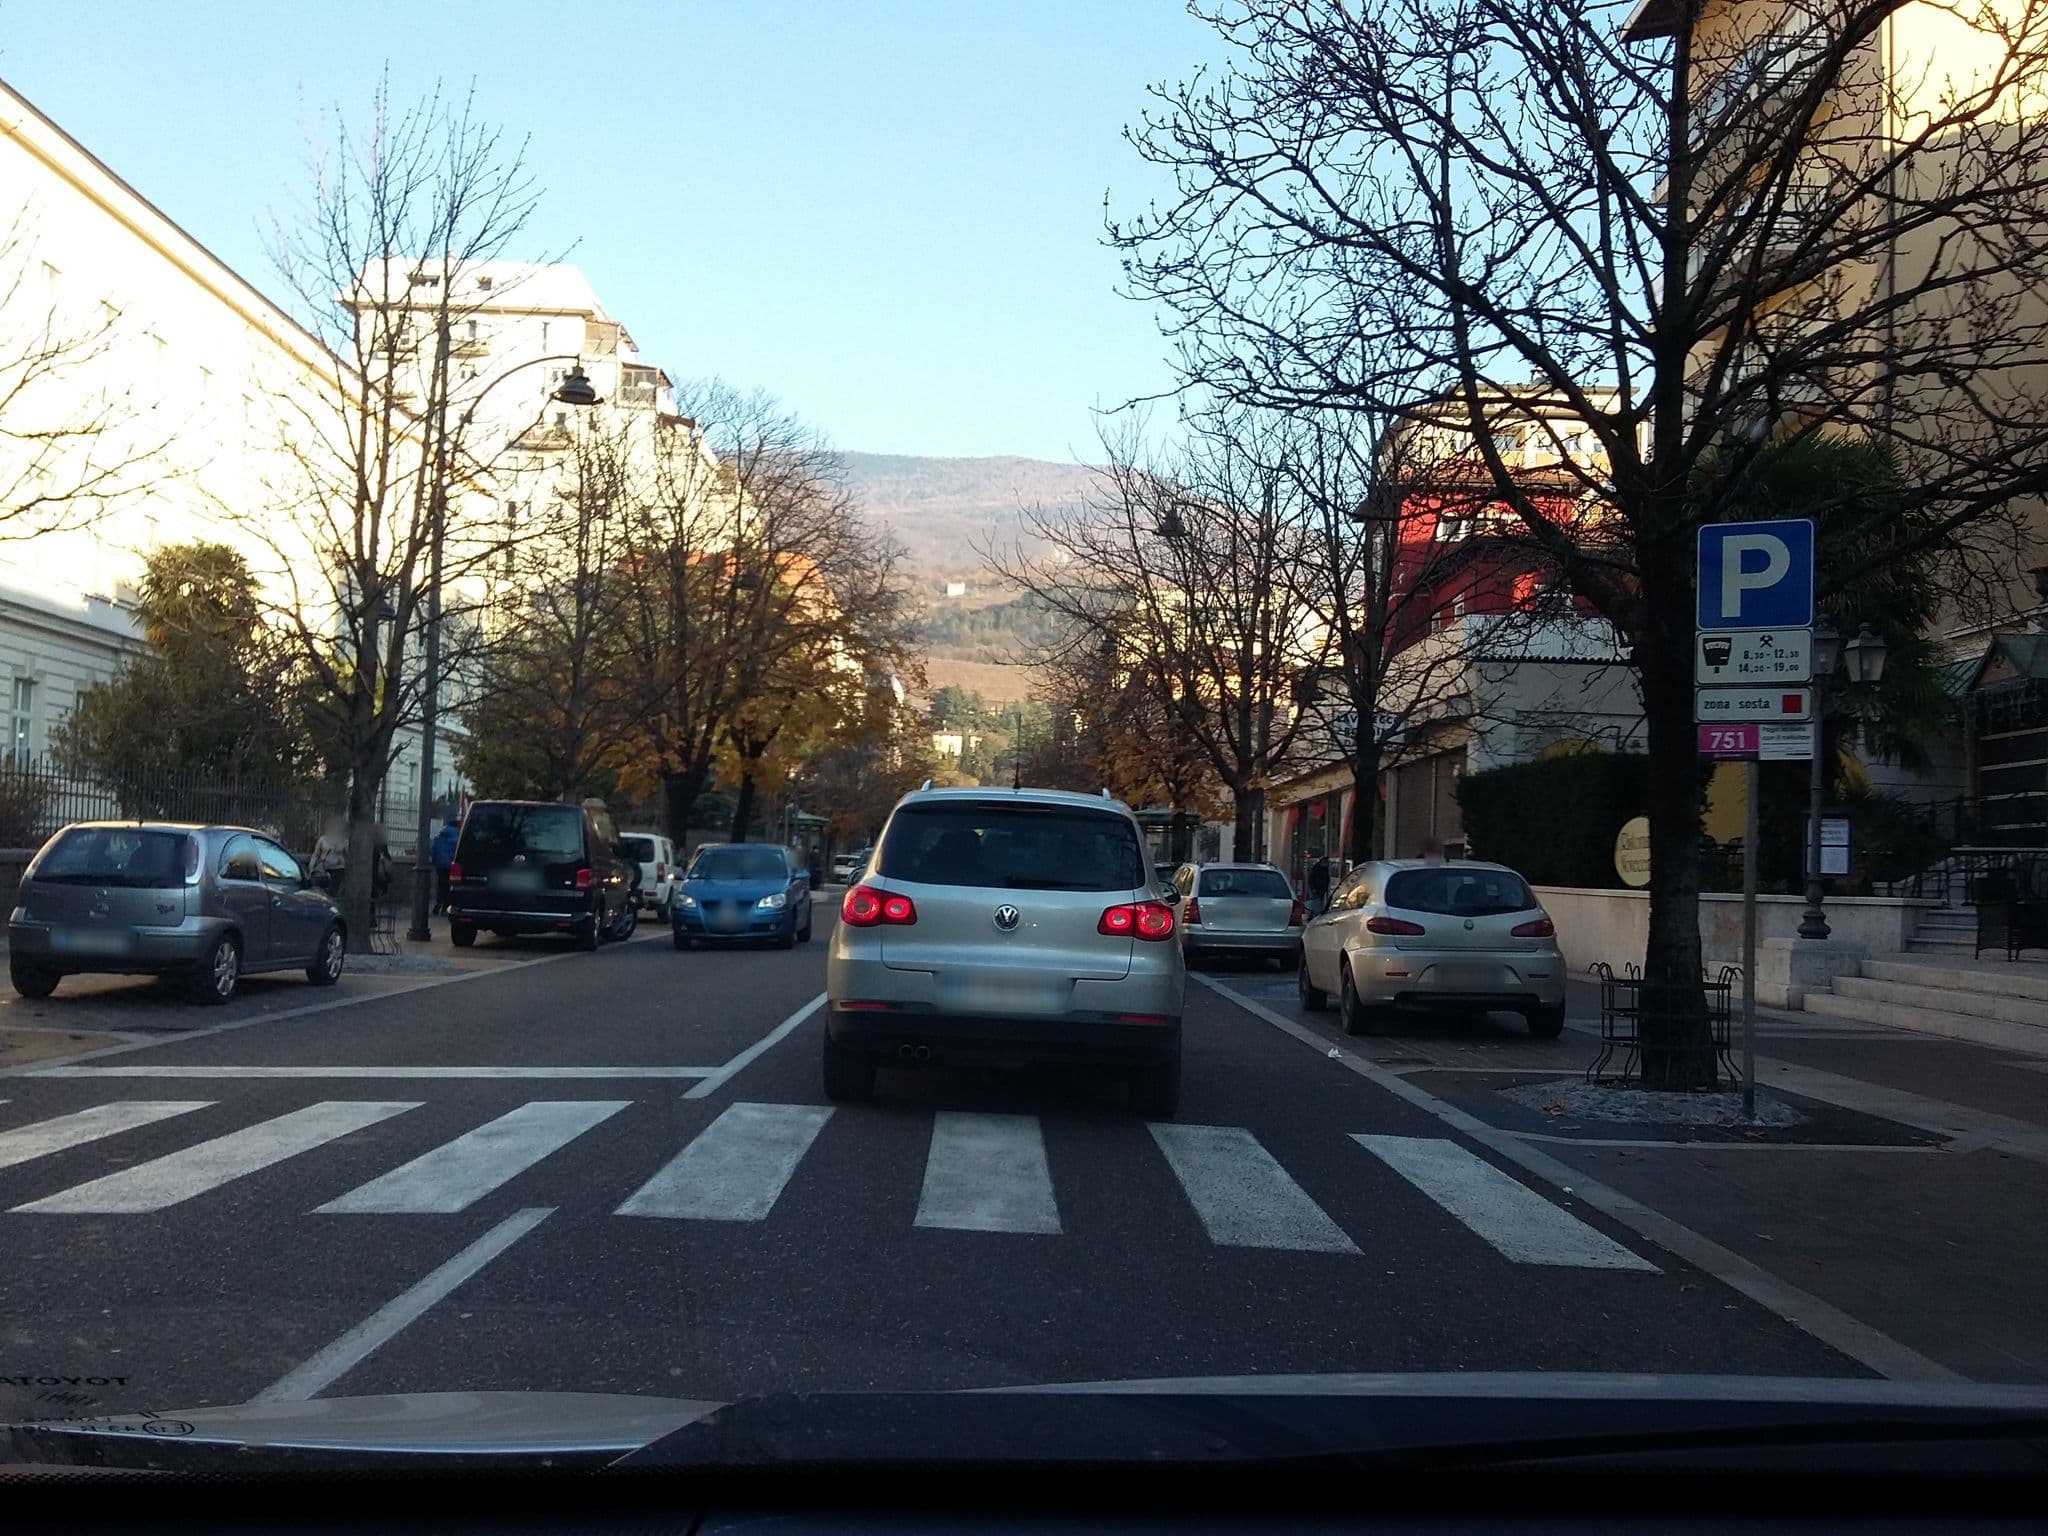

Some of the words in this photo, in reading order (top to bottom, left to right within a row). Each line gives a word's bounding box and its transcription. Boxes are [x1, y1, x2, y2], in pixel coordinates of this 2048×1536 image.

[1722, 534, 1790, 617] P
[1703, 700, 1730, 709] zona
[1738, 698, 1770, 709] sosta
[1709, 732, 1745, 749] 751
